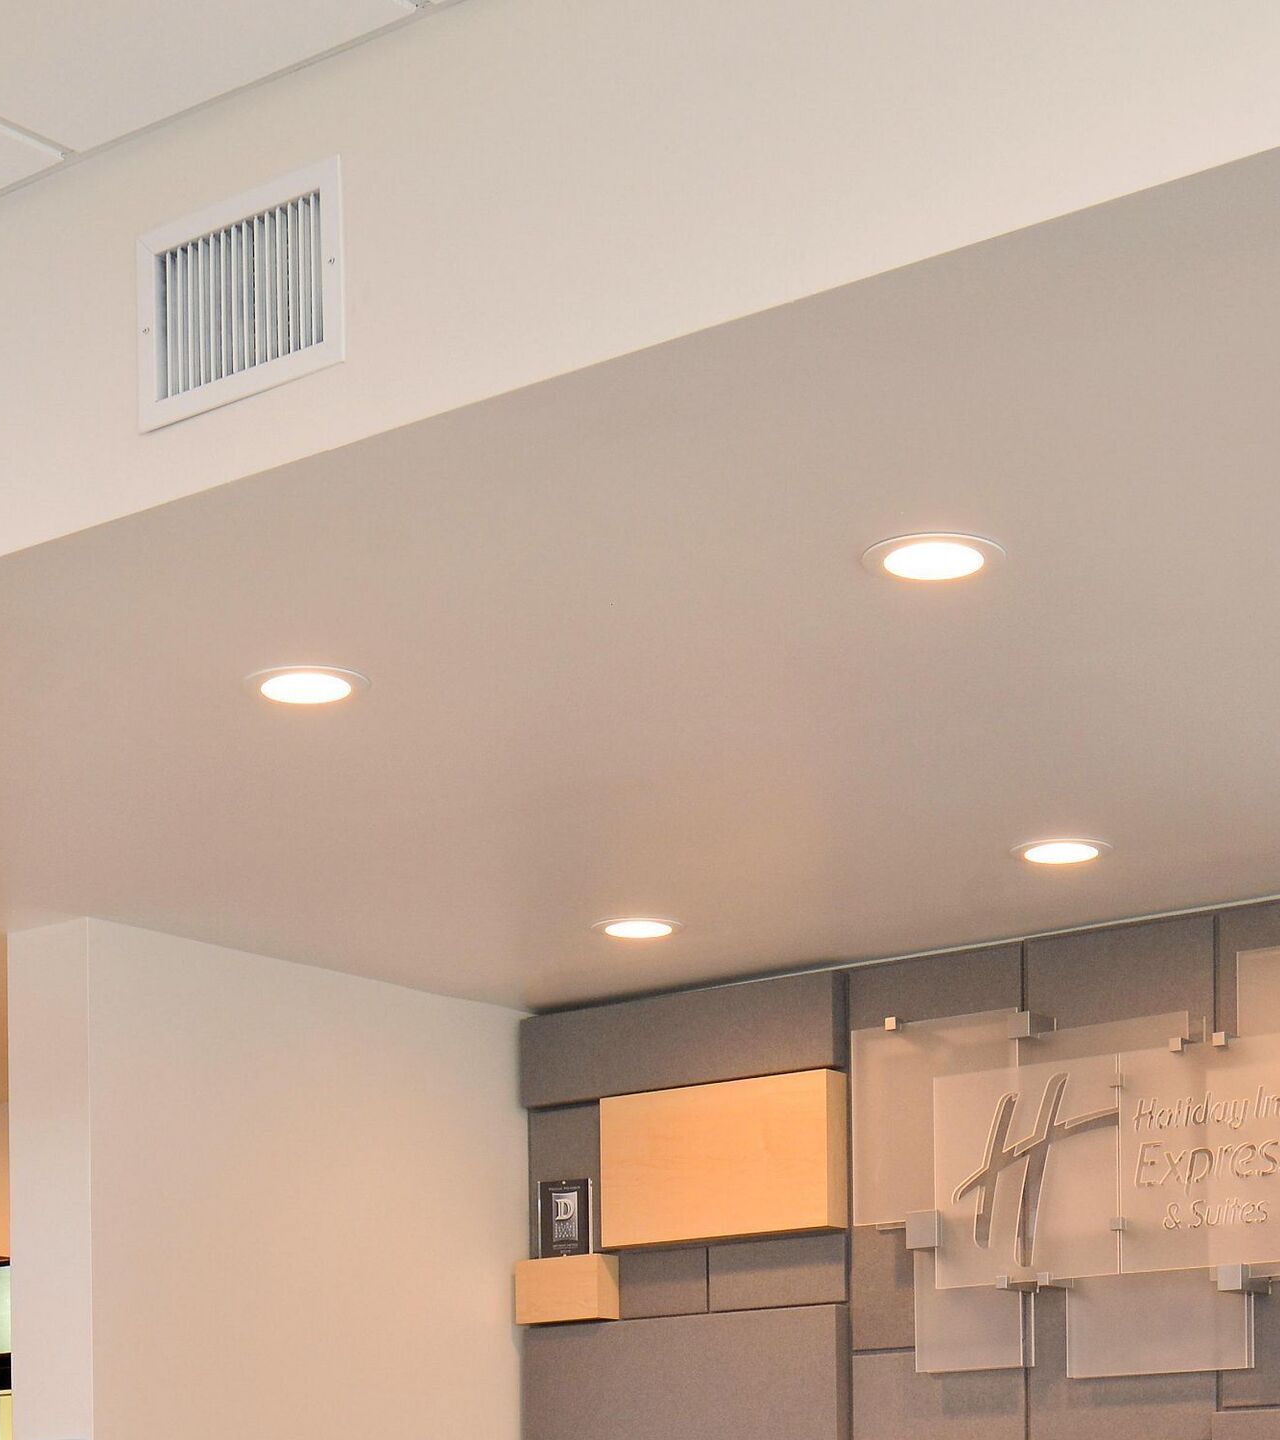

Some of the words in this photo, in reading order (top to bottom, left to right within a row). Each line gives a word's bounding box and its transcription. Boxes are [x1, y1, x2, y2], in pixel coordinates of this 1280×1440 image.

[1133, 1088, 1249, 1131] Holiday
[1163, 1202, 1181, 1230] &
[1188, 1197, 1269, 1228] Suites
